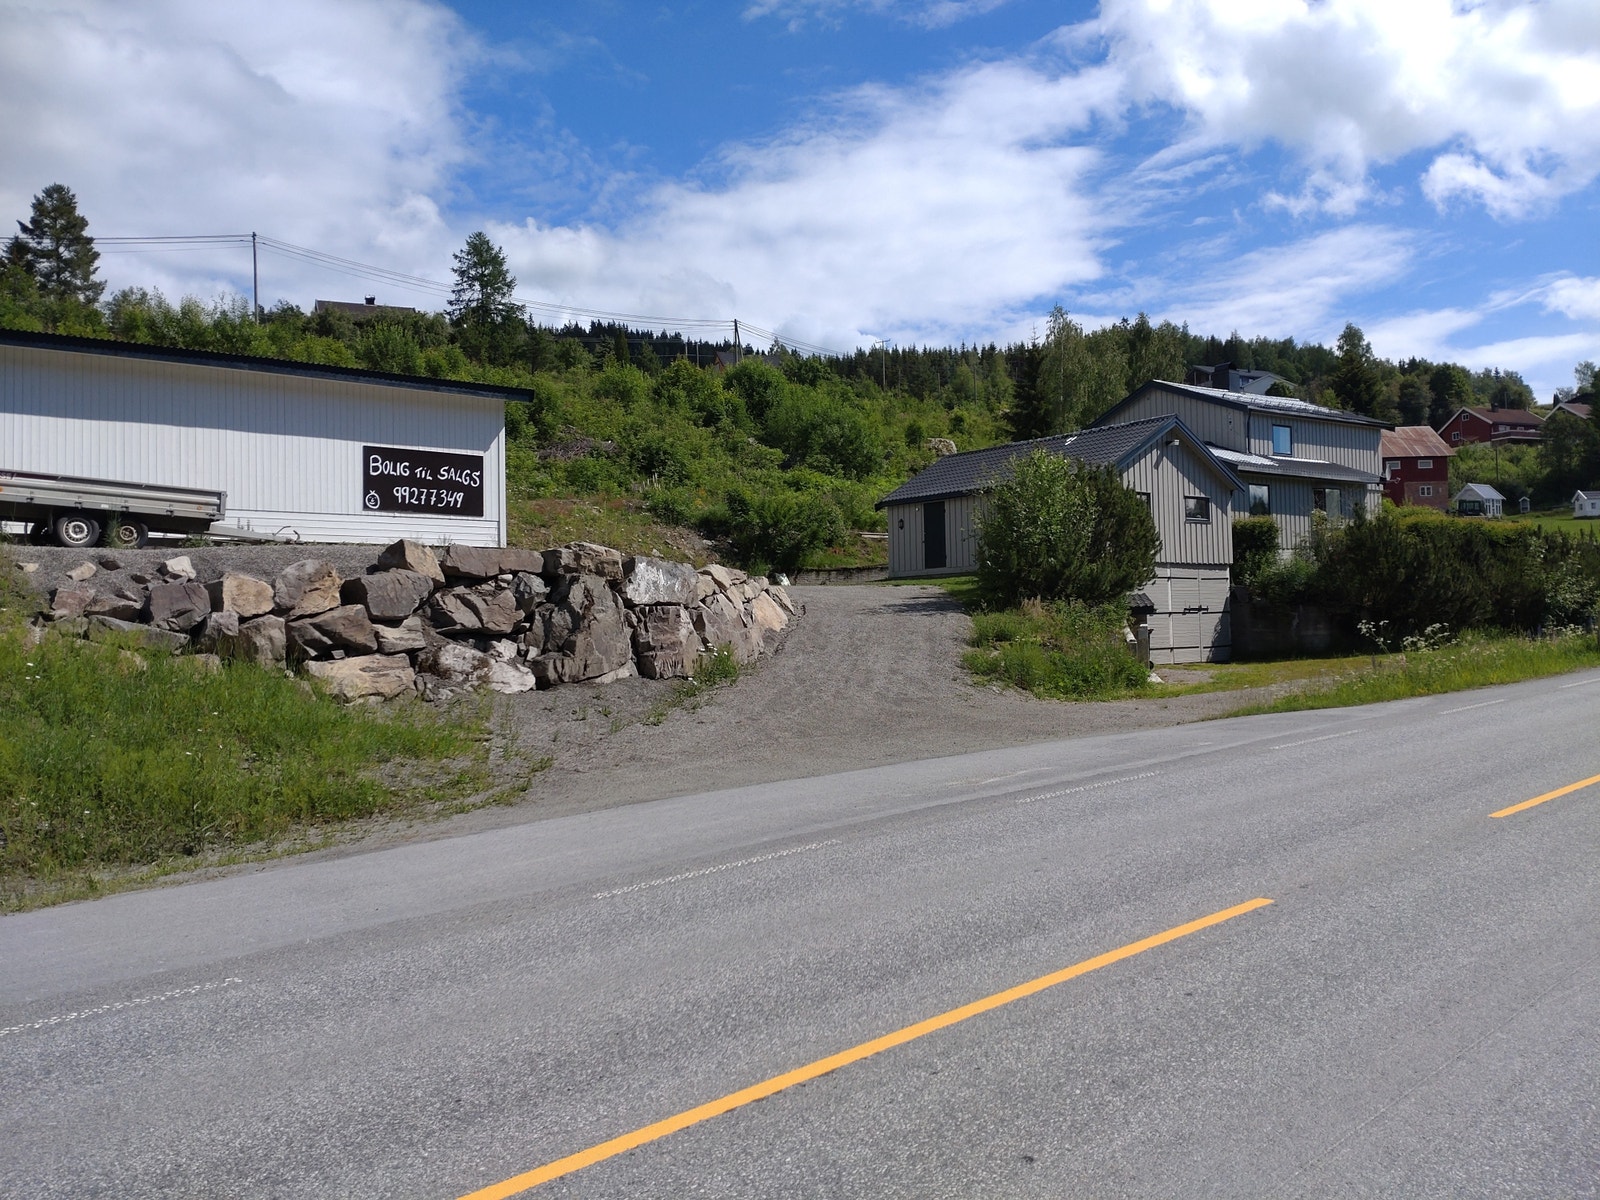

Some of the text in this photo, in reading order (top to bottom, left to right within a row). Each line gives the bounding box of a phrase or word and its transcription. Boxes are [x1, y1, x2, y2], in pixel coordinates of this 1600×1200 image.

[369, 454, 410, 476] BOLIG
[437, 465, 481, 487] SALGS
[393, 486, 464, 508] 99277349
